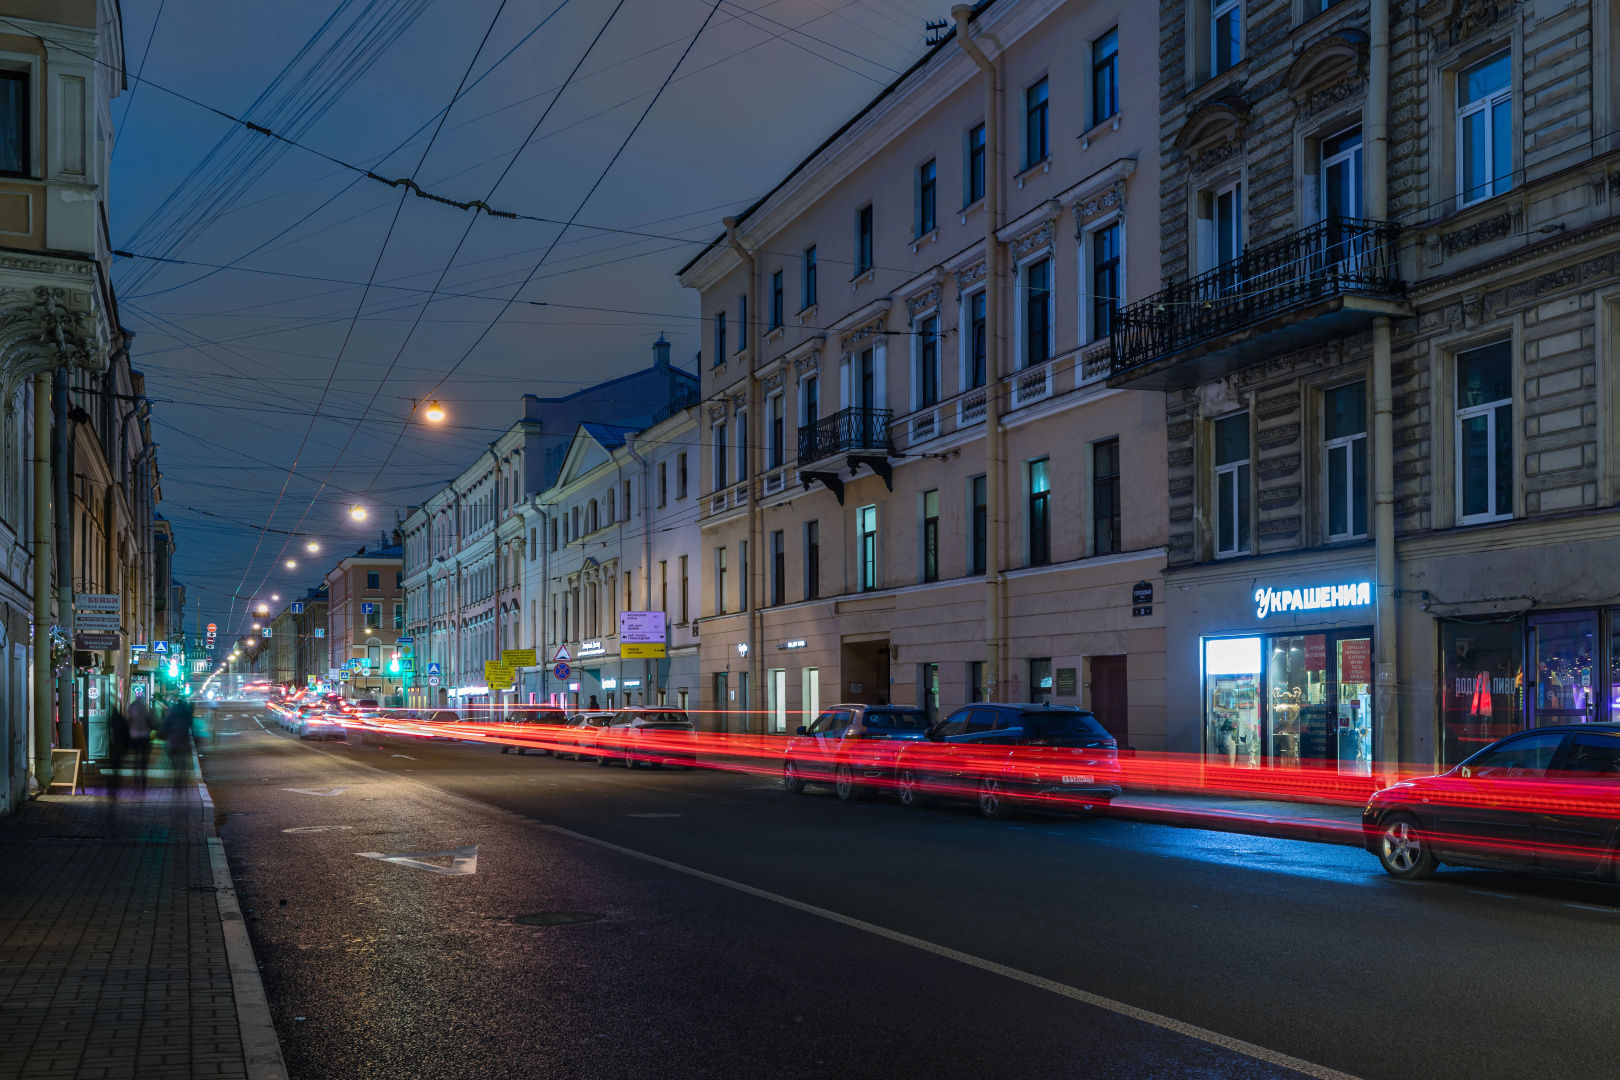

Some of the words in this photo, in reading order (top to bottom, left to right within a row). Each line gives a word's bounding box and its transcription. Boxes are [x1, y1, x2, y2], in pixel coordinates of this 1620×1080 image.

[1256, 583, 1370, 618] УКРАШЕНИЯ
[1455, 678, 1483, 695] ВОДКА
[1493, 678, 1516, 694] ПИВО
